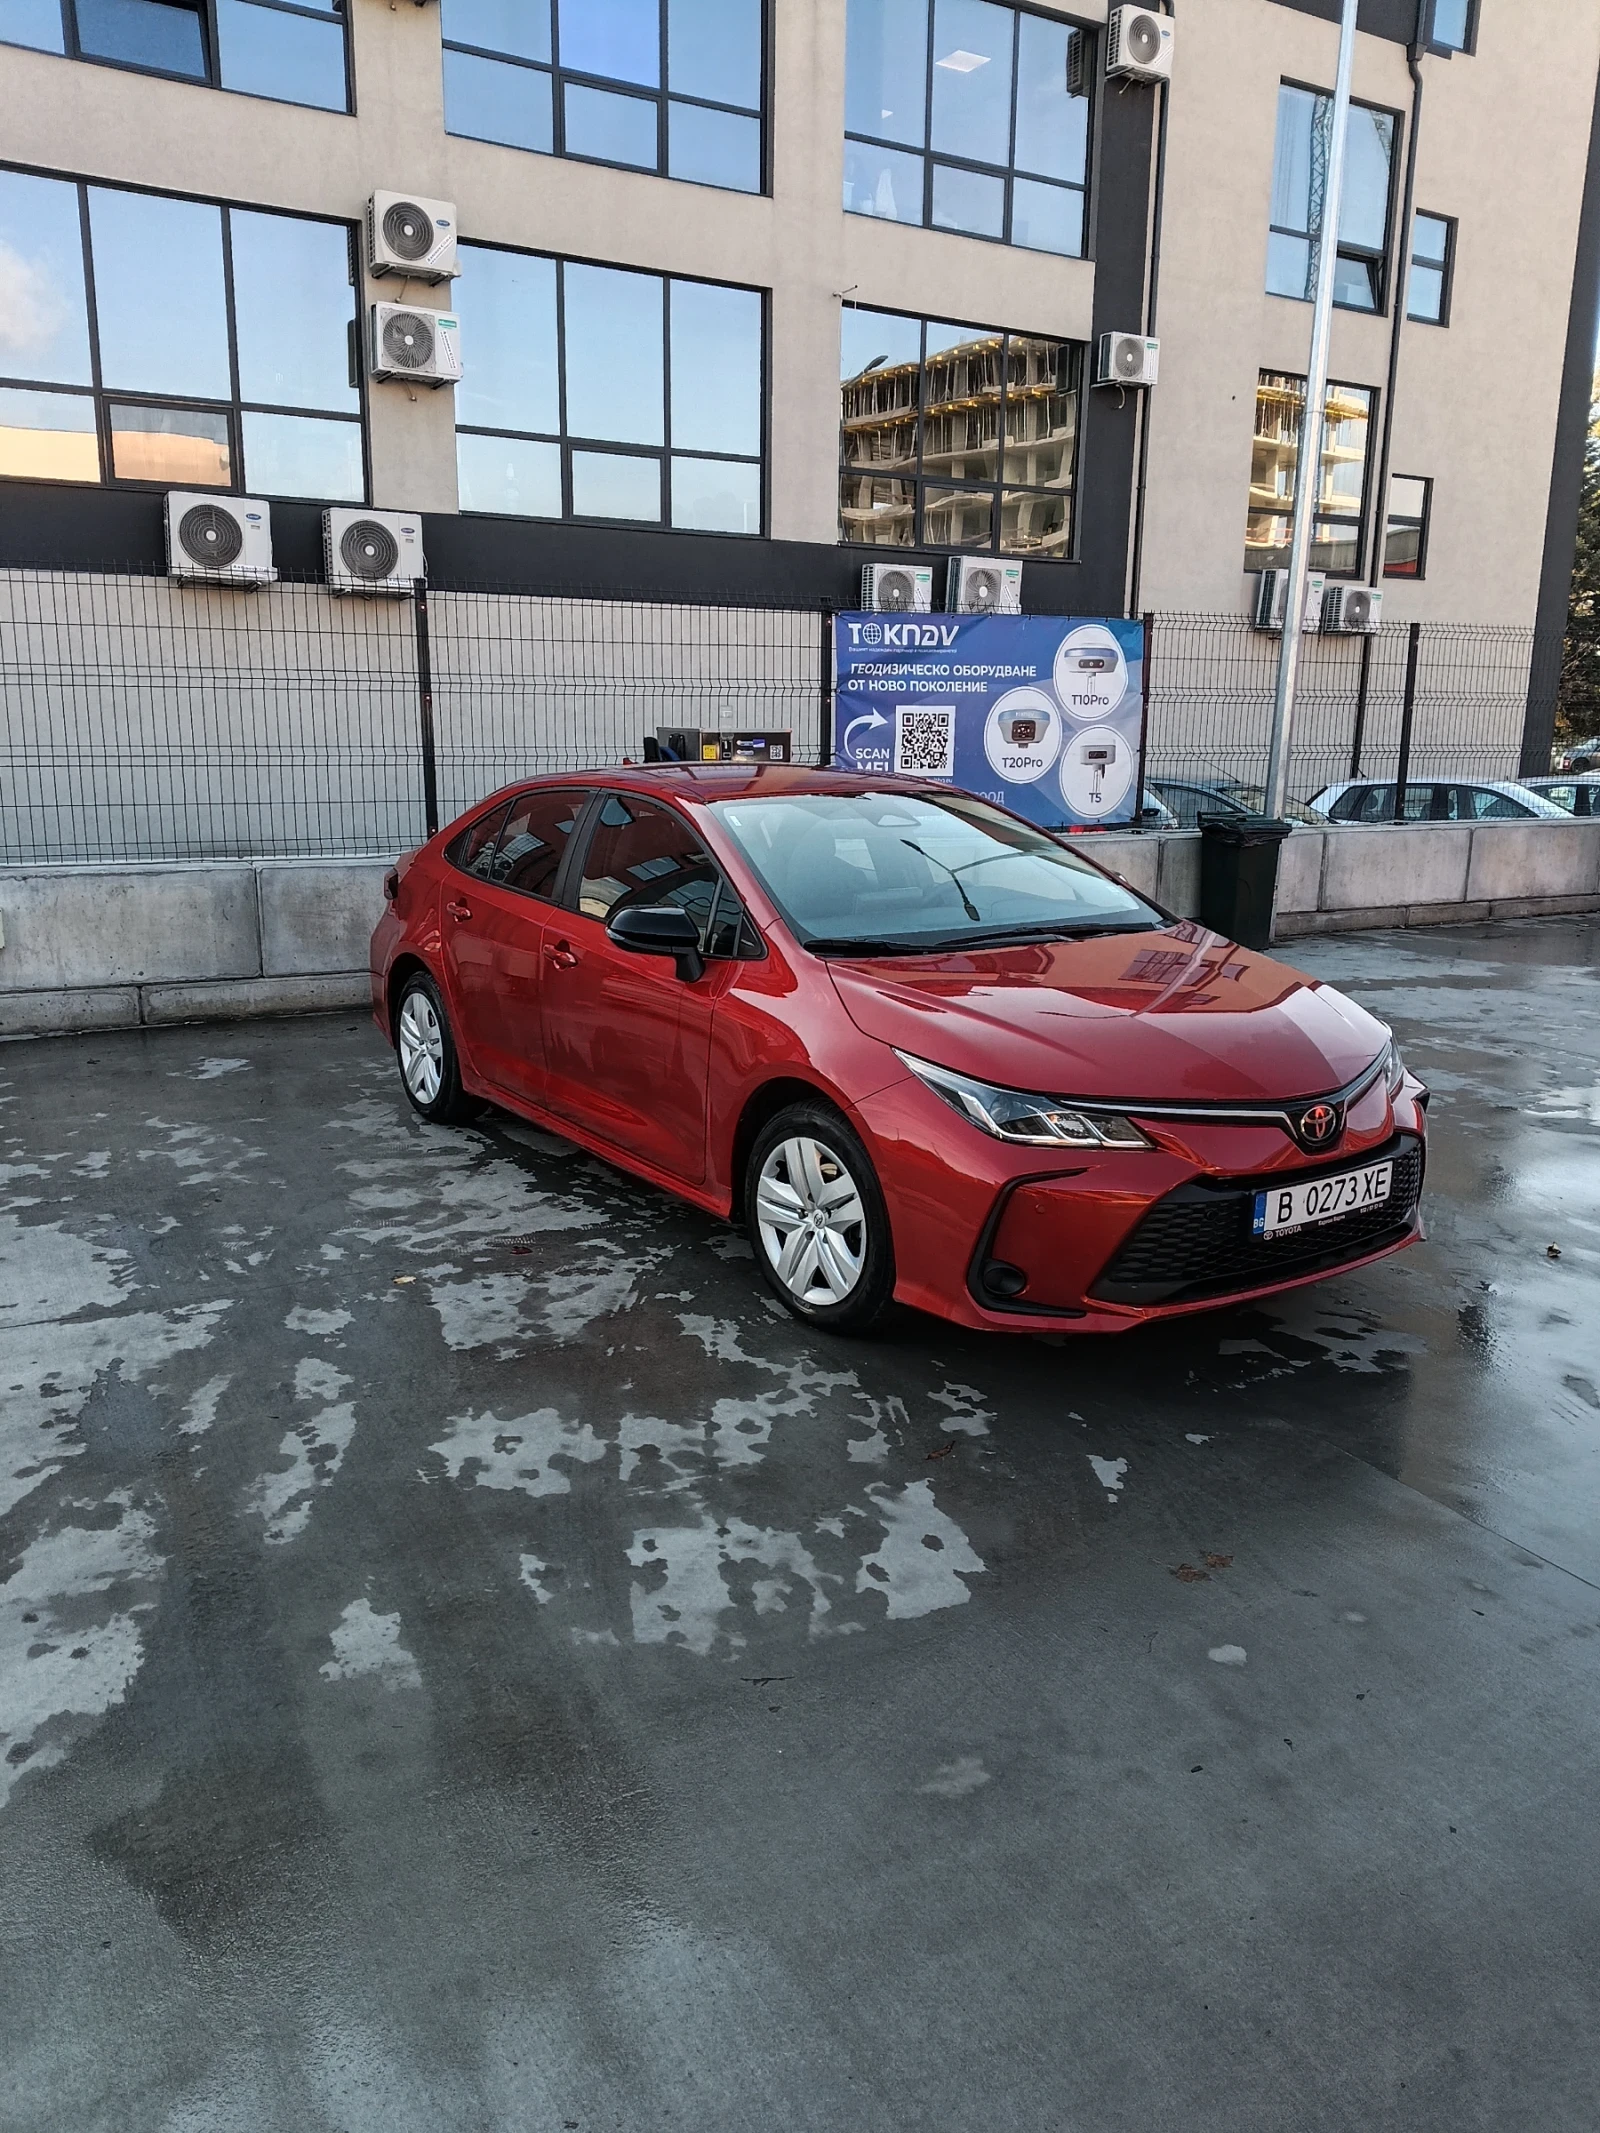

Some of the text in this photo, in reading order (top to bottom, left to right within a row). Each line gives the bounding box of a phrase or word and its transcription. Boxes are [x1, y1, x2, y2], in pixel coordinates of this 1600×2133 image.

[850, 663, 1037, 678] ГЕОДИЗИЧЕСКО ОБОРУДВАНЕ
[847, 679, 988, 693] ОТ НОВО ПОКОЛЕНИЕ
[1071, 694, 1110, 706] T10Pro
[855, 748, 890, 760] SCAN
[1002, 757, 1044, 769] T20Pro
[1088, 792, 1102, 804] T5
[1277, 1167, 1389, 1225] B 0273 XE
[1253, 1217, 1264, 1229] BG
[1275, 1224, 1302, 1238] TOYOTA
